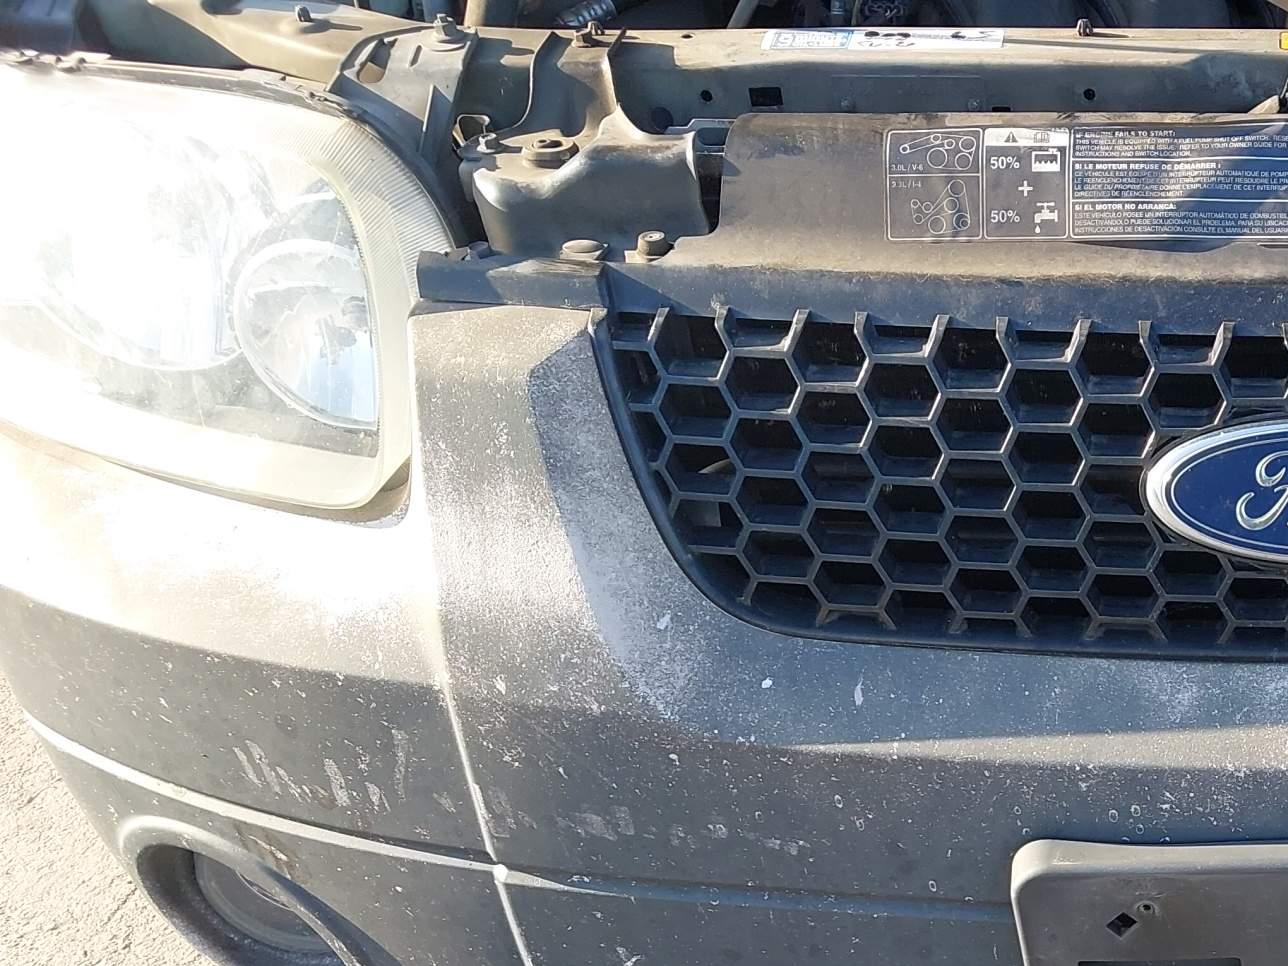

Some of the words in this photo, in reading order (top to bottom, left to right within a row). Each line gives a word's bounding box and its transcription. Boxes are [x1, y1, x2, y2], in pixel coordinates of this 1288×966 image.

[989, 156, 1020, 170] 50%
[1084, 203, 1094, 211] EL
[990, 210, 1021, 223] 50%
